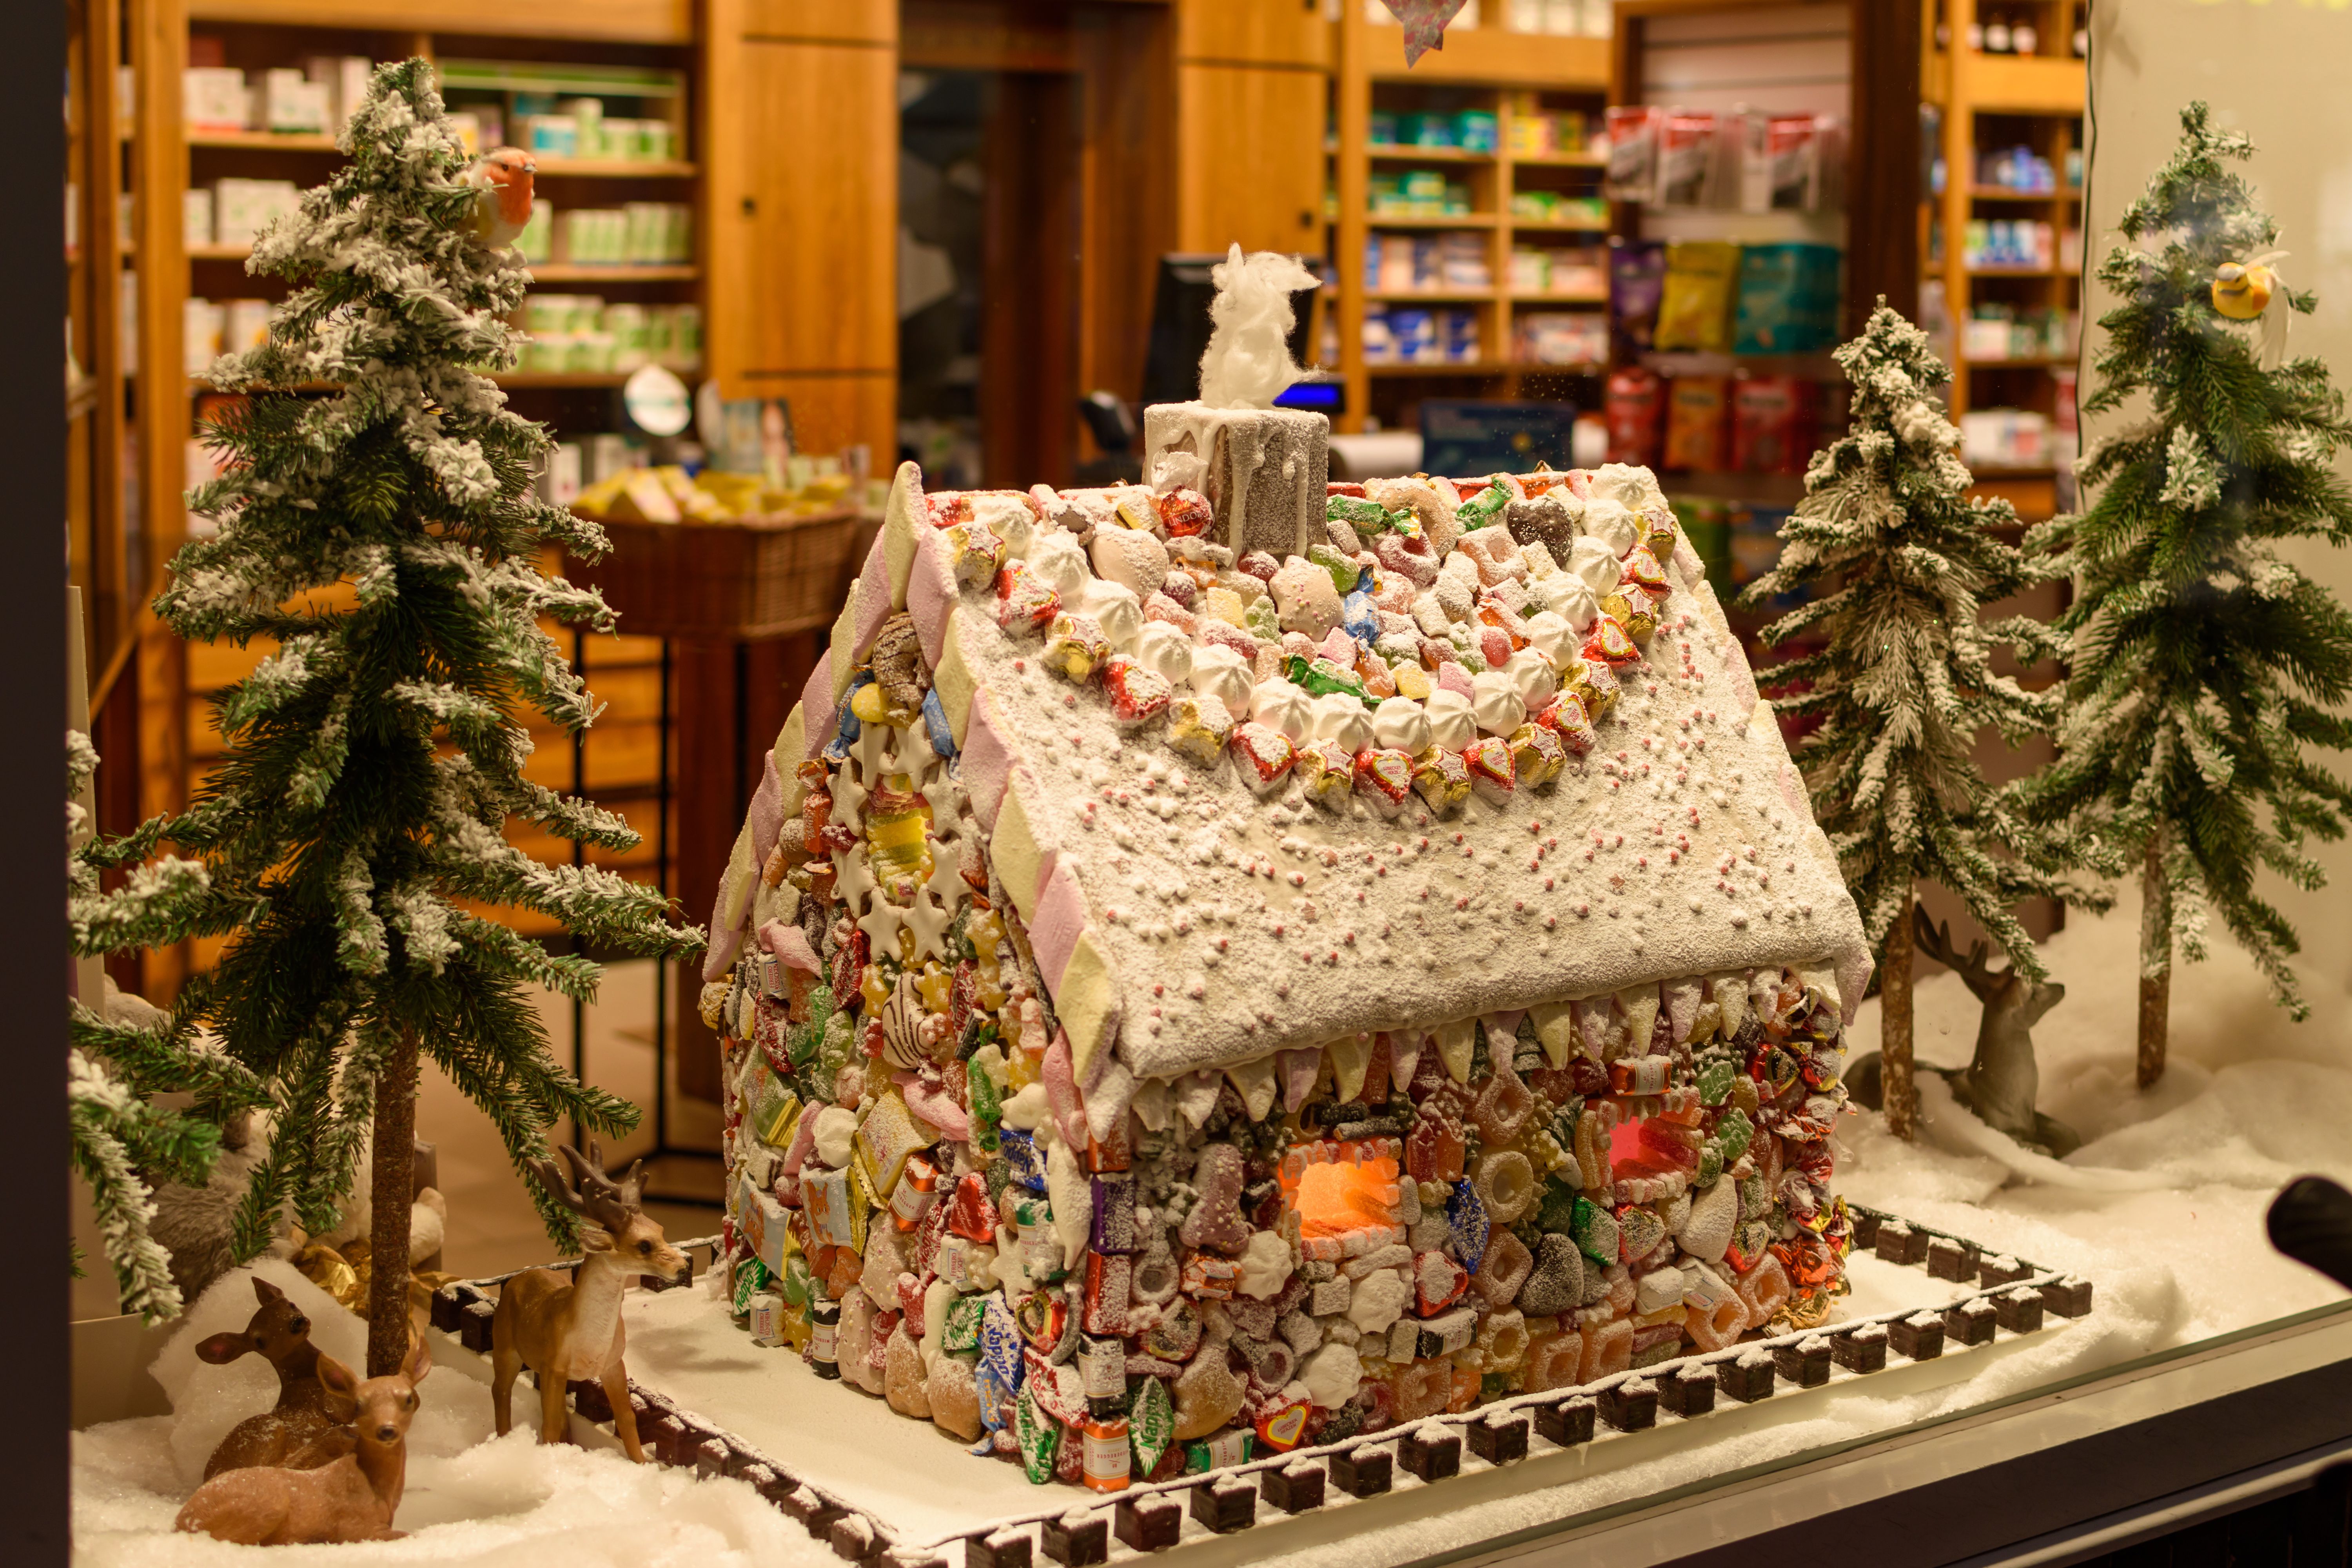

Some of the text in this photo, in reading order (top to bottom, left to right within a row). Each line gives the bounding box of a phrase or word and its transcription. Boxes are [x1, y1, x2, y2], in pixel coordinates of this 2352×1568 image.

[954, 980, 970, 1032] Nappo
[1003, 1142, 1036, 1174] Nappo
[916, 1199, 924, 1215] ORANGE
[918, 1216, 936, 1272] Nappo
[735, 1270, 754, 1313] Nappo
[1018, 1398, 1035, 1453] Nappo
[1138, 1395, 1163, 1452] Nappo
[1277, 1418, 1298, 1432] LÜBECKER
[1280, 1423, 1297, 1435] HERZEN
